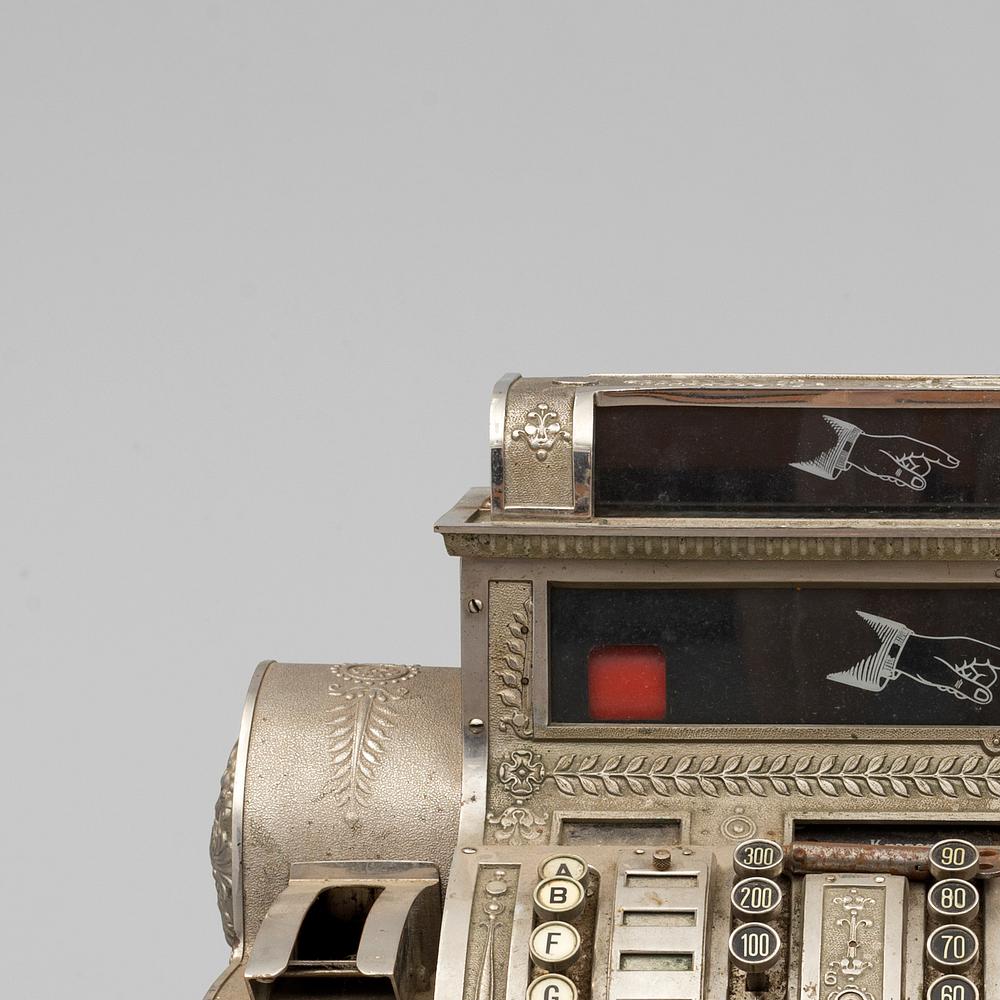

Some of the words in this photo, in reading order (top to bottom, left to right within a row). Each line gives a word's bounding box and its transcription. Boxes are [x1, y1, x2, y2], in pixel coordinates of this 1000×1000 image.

[744, 847, 774, 866] 300
[940, 847, 965, 866] 90
[555, 863, 574, 878] A
[549, 886, 568, 904] B
[740, 887, 772, 908] 200
[940, 887, 966, 909] 80
[544, 932, 562, 954] F
[740, 933, 770, 957] 100
[941, 934, 965, 959] 70
[824, 970, 838, 986] 6
